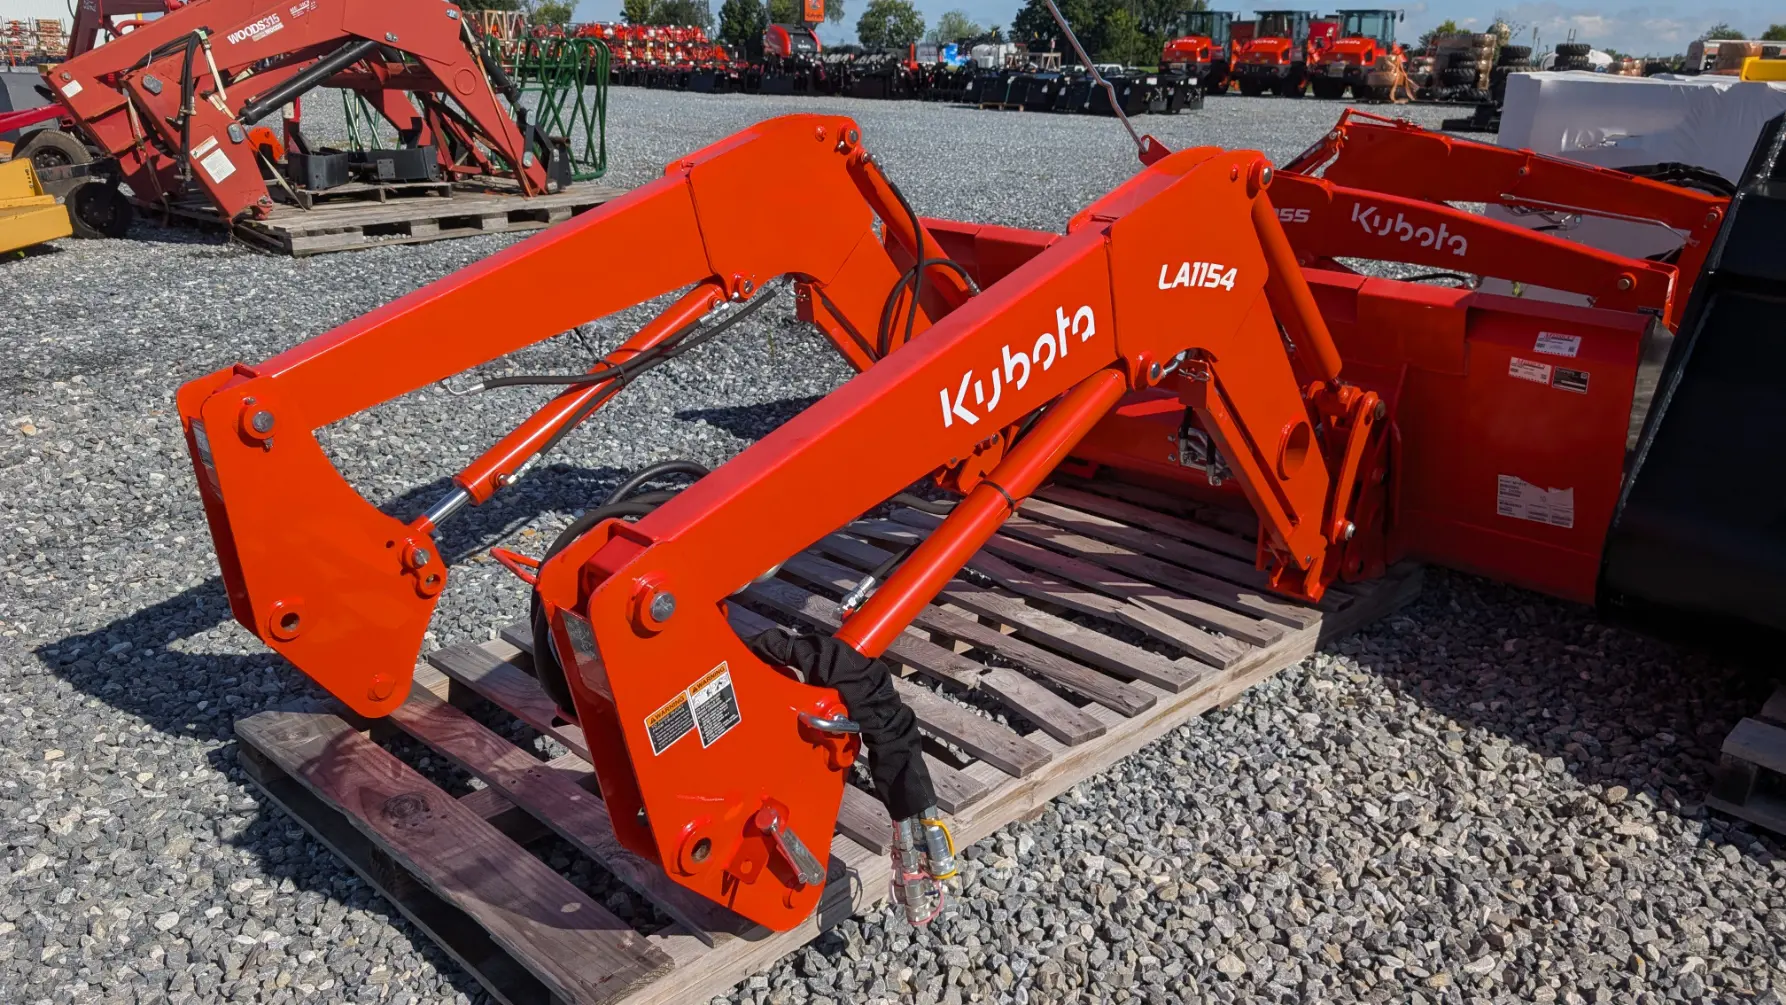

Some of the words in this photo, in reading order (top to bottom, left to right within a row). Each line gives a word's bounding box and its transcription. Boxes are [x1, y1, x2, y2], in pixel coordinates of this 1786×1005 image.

[1350, 202, 1468, 256] Kubota
[1158, 261, 1238, 291] LA1154
[939, 305, 1096, 428] Kubota
[696, 665, 726, 688] WARNING
[654, 695, 685, 718] WARNING
